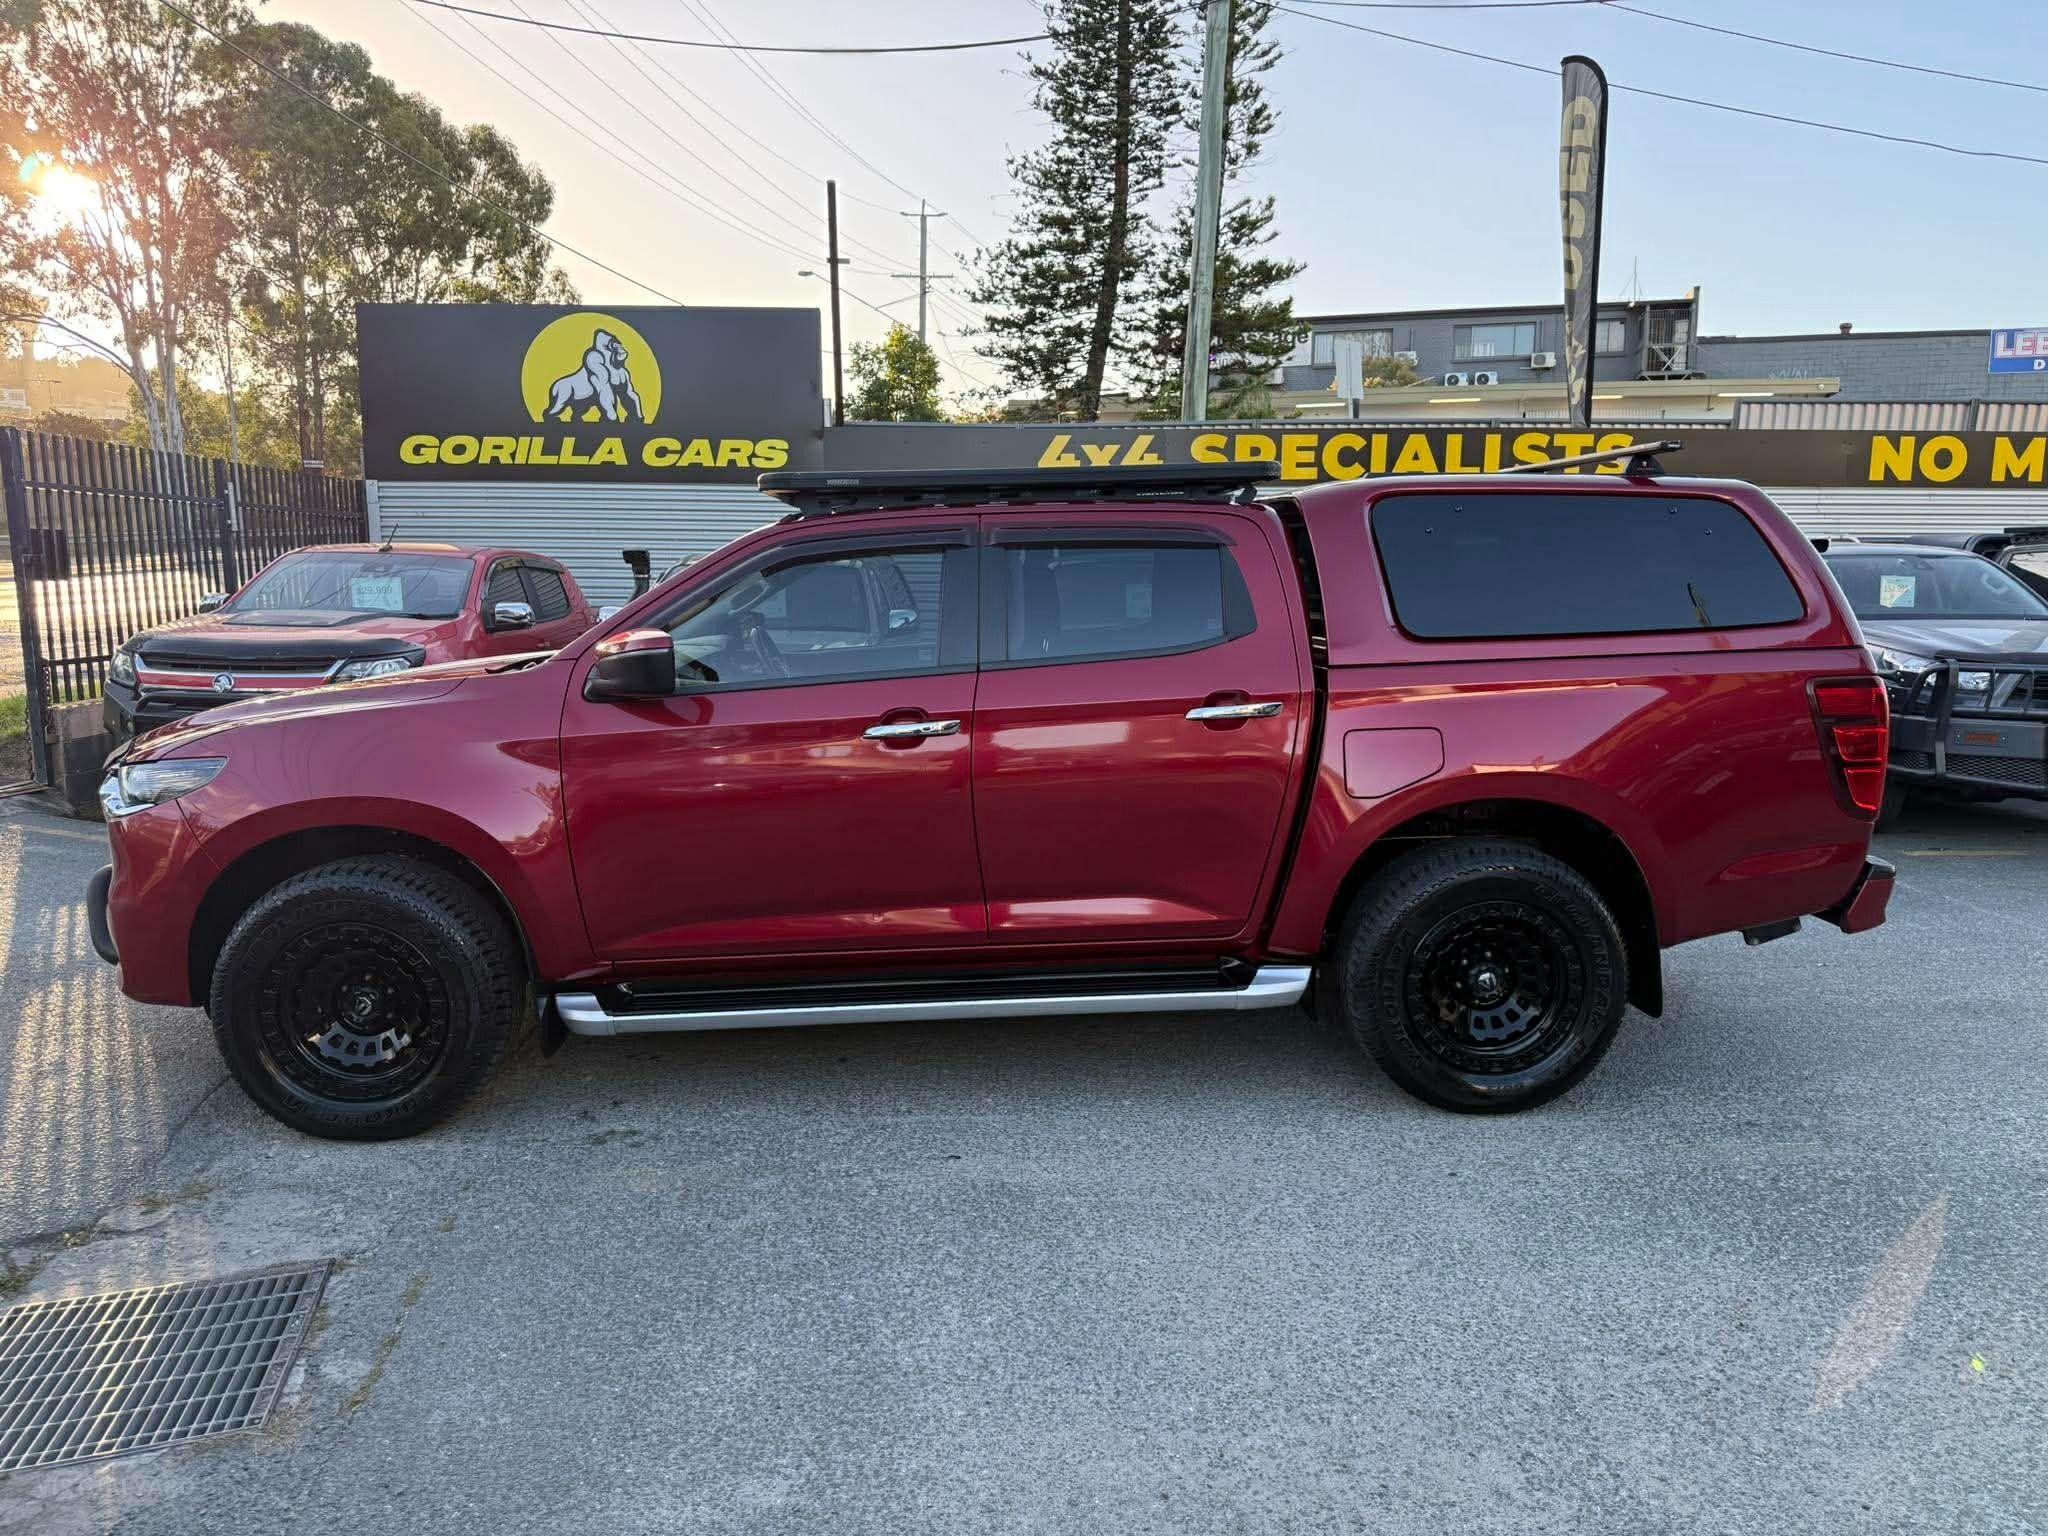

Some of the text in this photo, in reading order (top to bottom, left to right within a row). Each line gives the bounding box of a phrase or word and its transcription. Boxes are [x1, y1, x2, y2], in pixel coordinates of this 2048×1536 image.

[400, 434, 789, 469] GORILLA CARS
[1038, 432, 1633, 481] 4x4 SPECIALISTS
[1868, 435, 2048, 482] NO M
